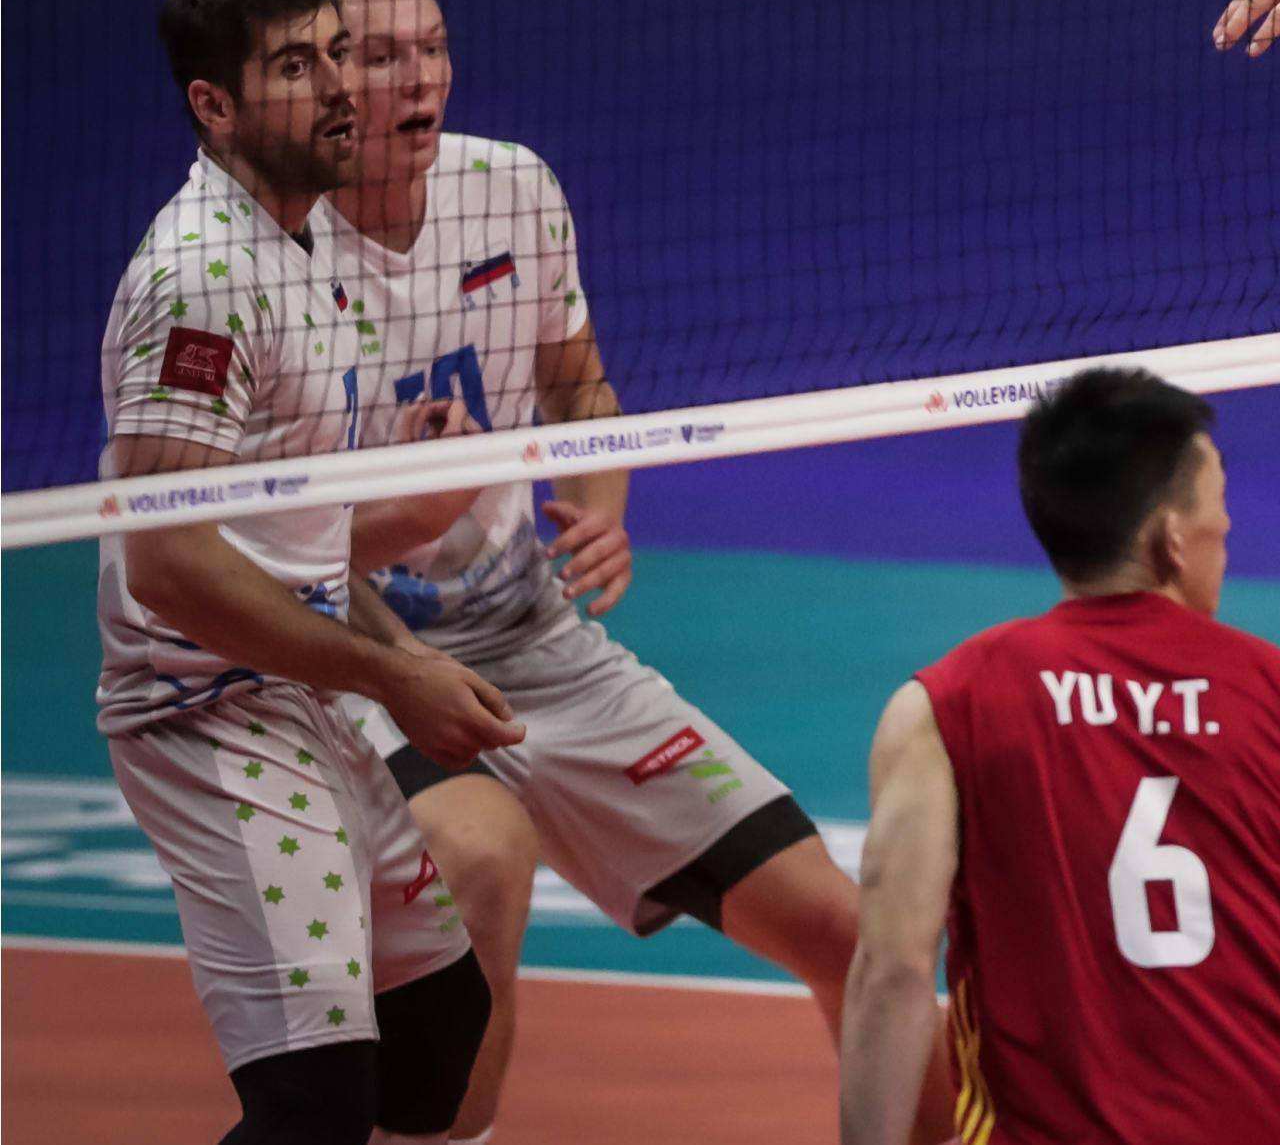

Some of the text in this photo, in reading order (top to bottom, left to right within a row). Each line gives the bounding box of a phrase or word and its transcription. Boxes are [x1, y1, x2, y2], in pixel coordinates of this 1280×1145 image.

[549, 432, 644, 460] VOLLEYBALL
[128, 486, 226, 514] VOLLEYBALL
[1039, 670, 1220, 736] YU Y.T.
[1108, 775, 1216, 969] 6
